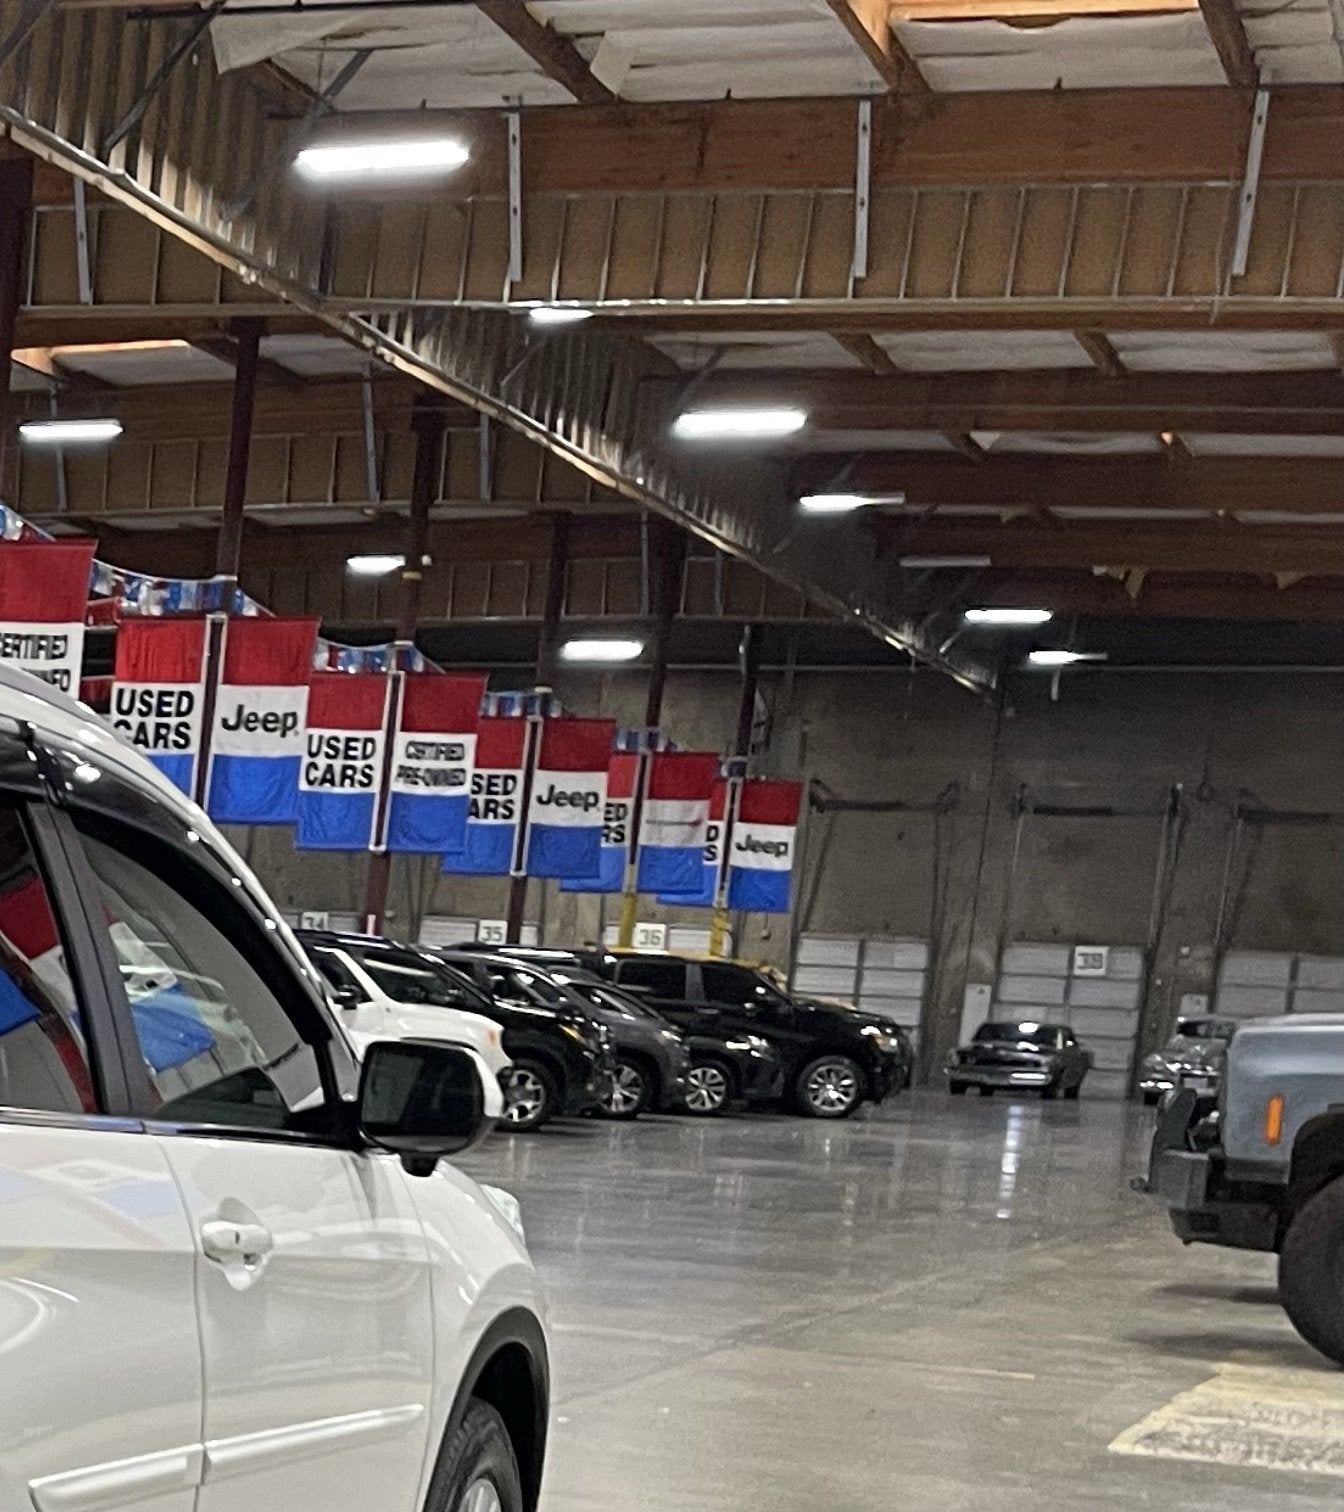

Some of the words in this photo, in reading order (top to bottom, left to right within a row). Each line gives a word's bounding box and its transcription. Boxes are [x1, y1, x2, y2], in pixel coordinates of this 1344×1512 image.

[116, 688, 195, 718] USED
[221, 704, 298, 738] Jeep
[307, 734, 377, 761] USED
[305, 762, 375, 788] CARS
[470, 773, 518, 796] SED
[469, 798, 516, 820] ARS
[536, 784, 599, 812] Jeep
[603, 802, 628, 822] ED
[735, 834, 789, 858] Jeep
